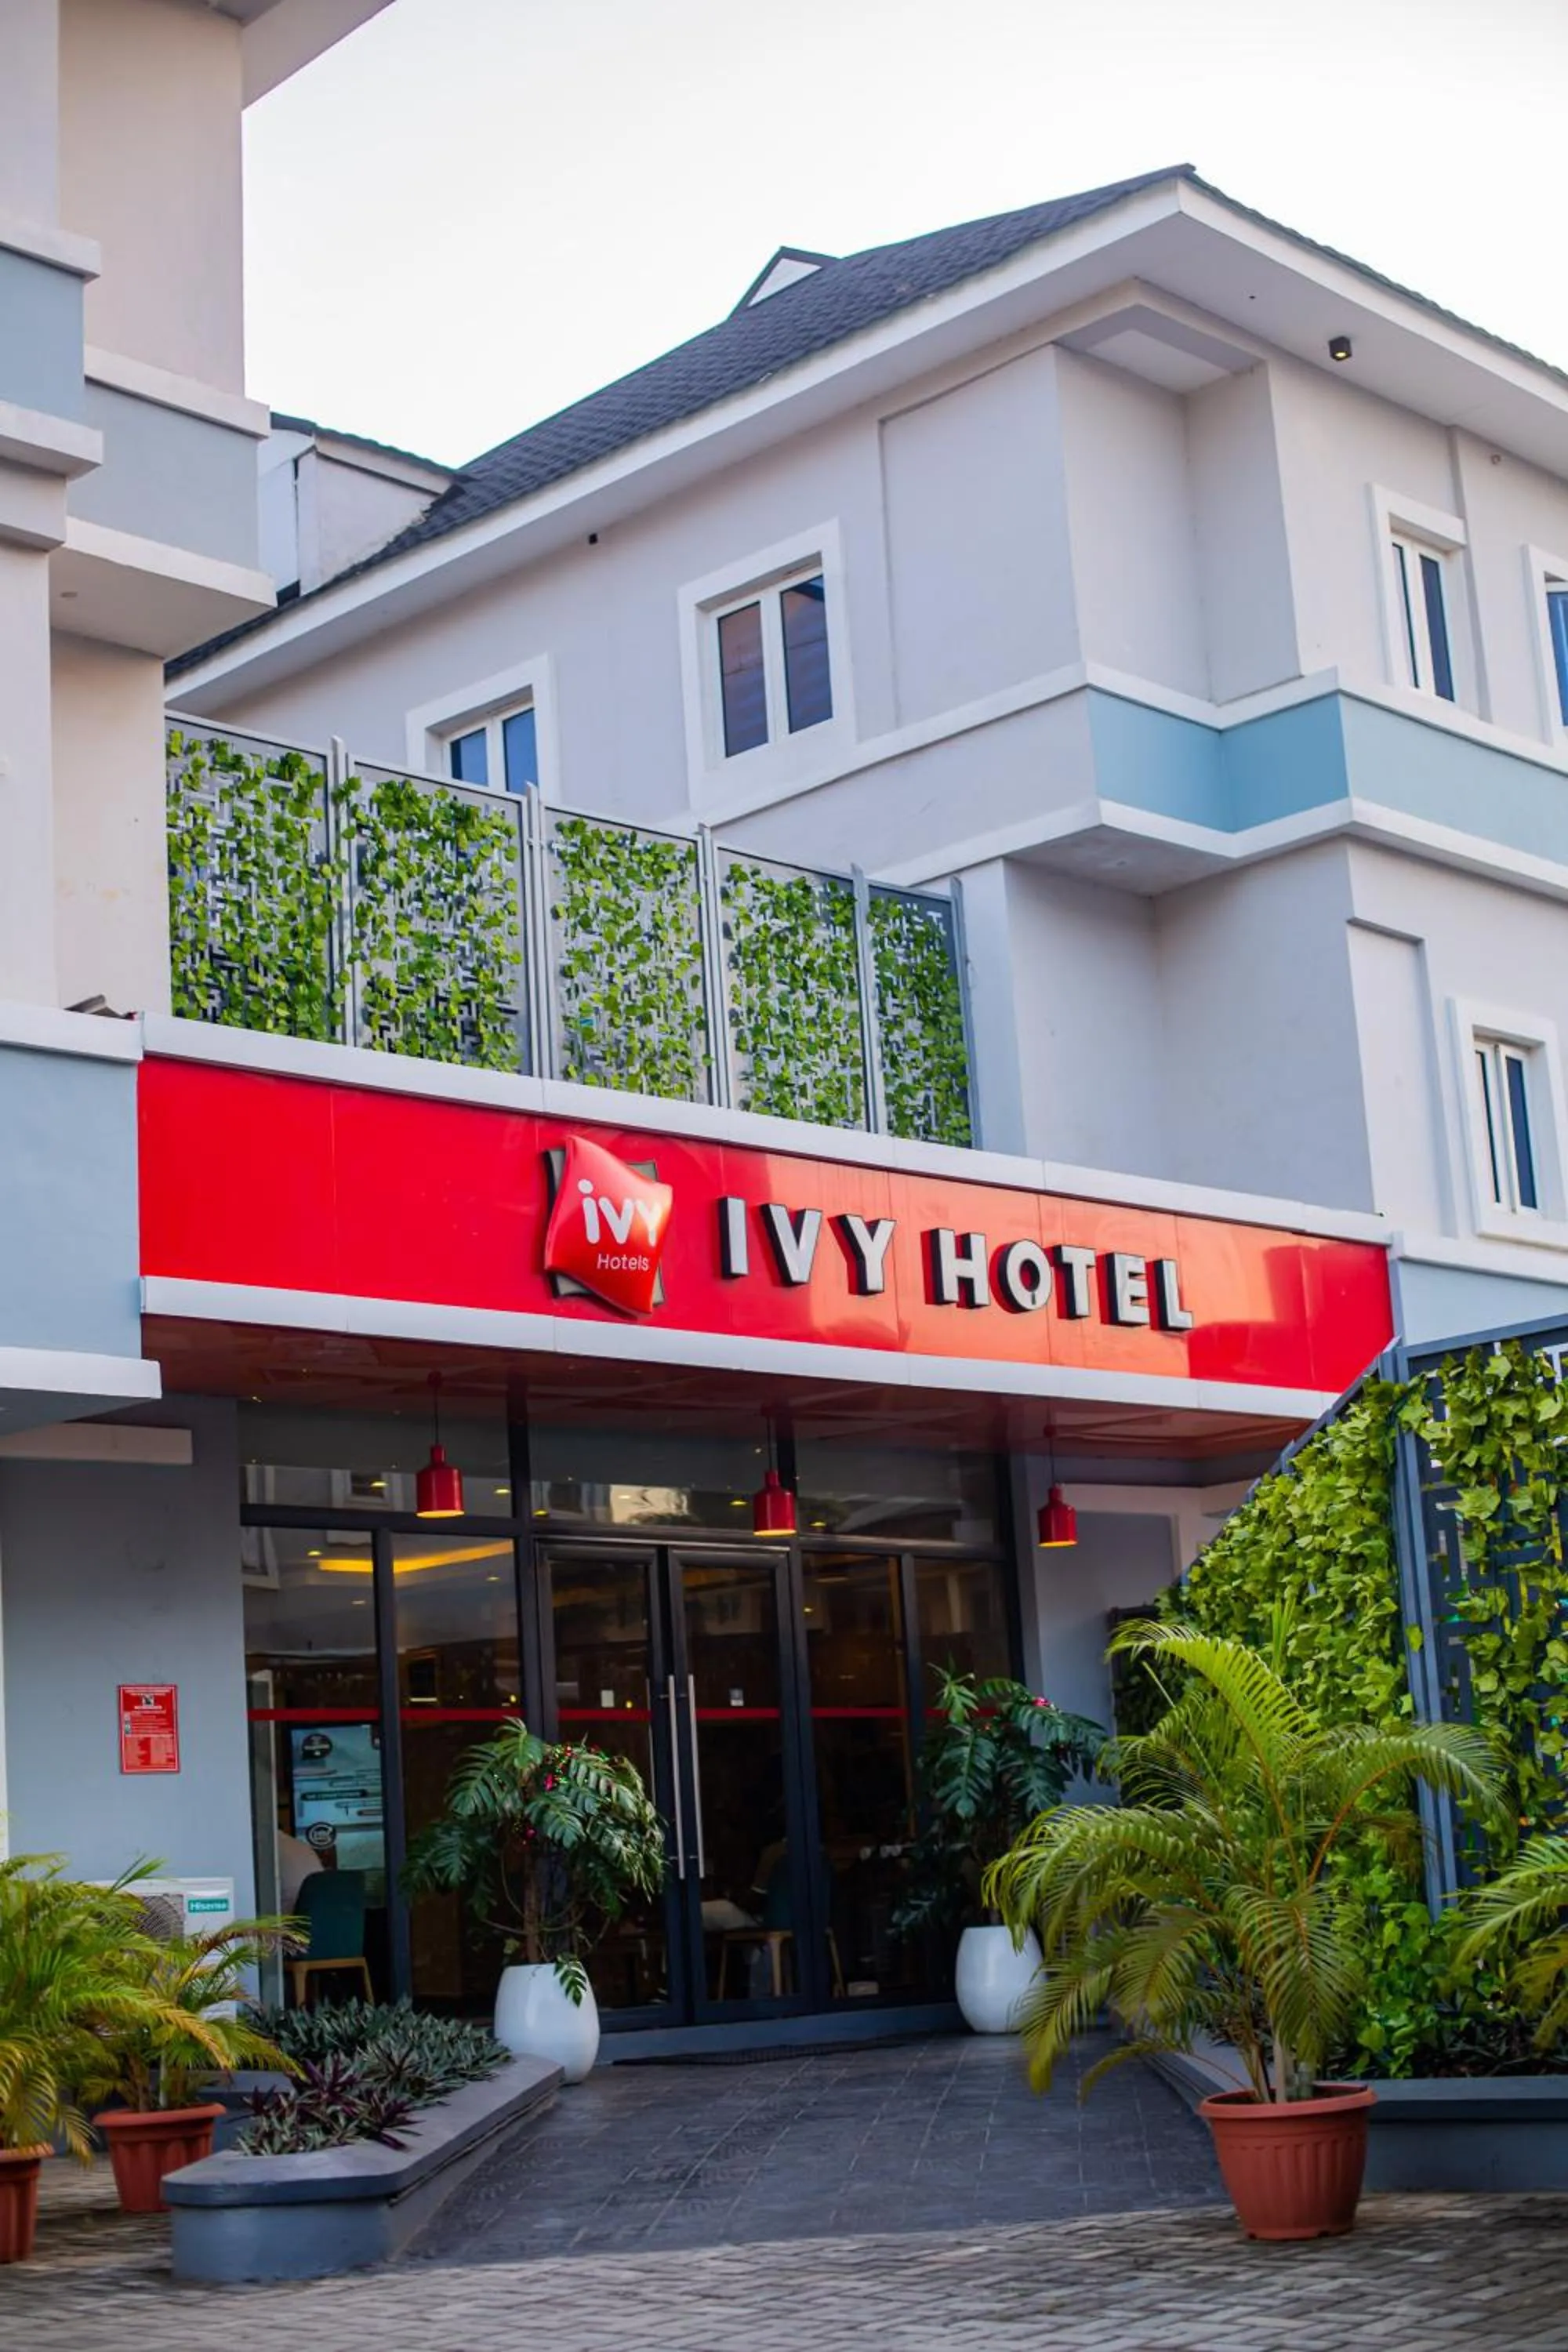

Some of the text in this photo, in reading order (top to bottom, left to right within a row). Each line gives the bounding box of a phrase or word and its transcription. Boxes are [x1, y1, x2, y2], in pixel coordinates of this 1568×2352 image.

[597, 1254, 649, 1272] Hotels
[718, 1195, 1193, 1332] IVY HOTEL
